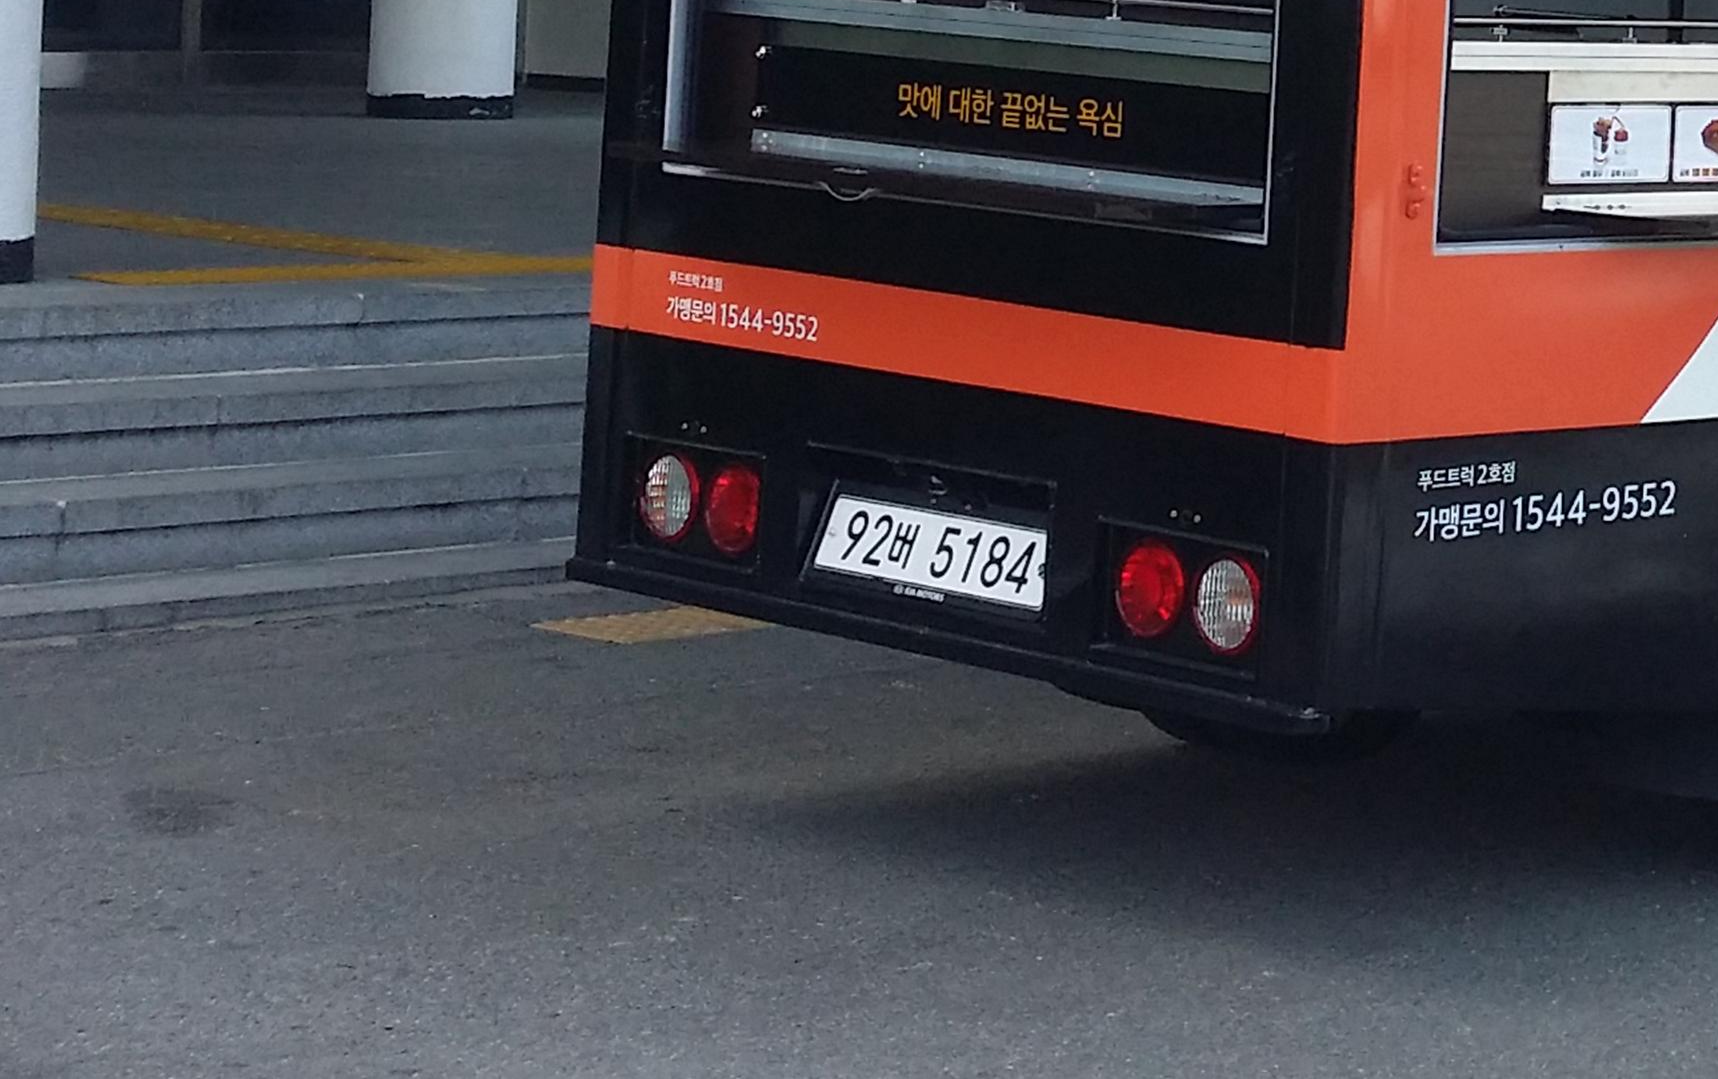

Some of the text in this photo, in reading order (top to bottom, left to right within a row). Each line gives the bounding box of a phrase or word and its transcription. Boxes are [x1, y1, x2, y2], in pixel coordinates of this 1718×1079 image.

[898, 82, 1123, 138] 맛에 대한 끝없는 욕심
[666, 296, 819, 342] 가맹문의 1544-9552
[1417, 460, 1516, 491] 푸드트럭 2호점
[1414, 480, 1677, 542] 가맹문의 1544-9552
[841, 510, 1037, 595] 92버 5184
